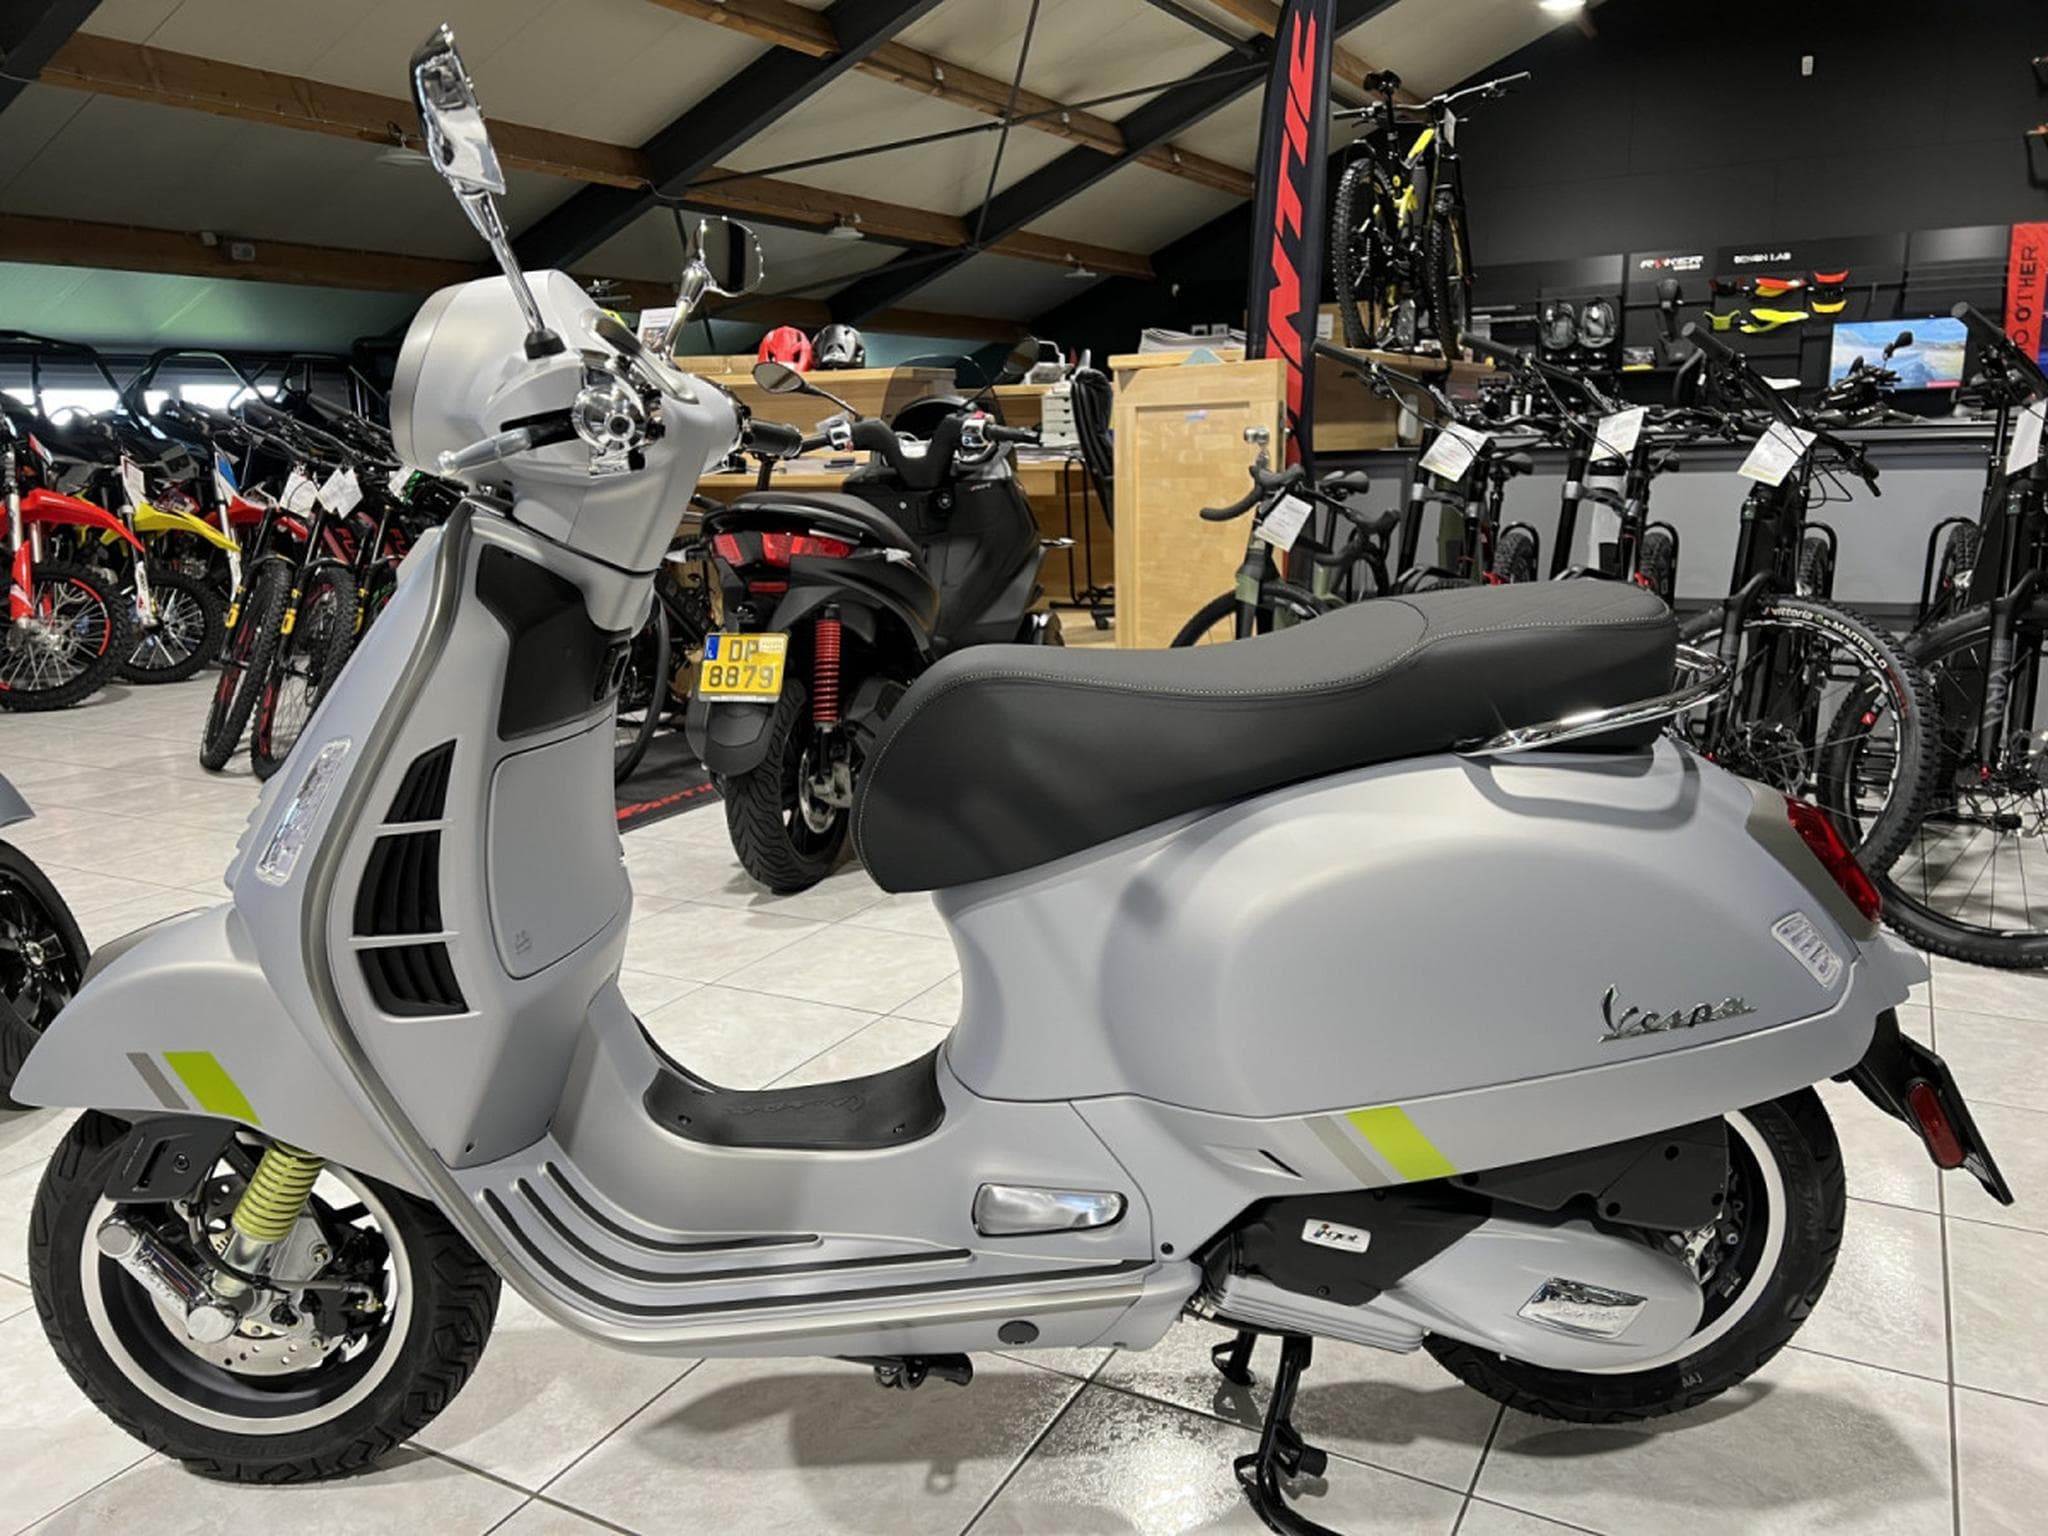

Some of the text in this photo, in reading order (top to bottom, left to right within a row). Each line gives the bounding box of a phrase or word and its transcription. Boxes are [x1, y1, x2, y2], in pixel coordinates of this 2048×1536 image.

[1770, 252, 1792, 262] LAB
[2014, 245, 2039, 323] OTHER
[728, 639, 760, 663] DP
[708, 665, 775, 689] 8879
[1598, 983, 1758, 1042] Vespa
